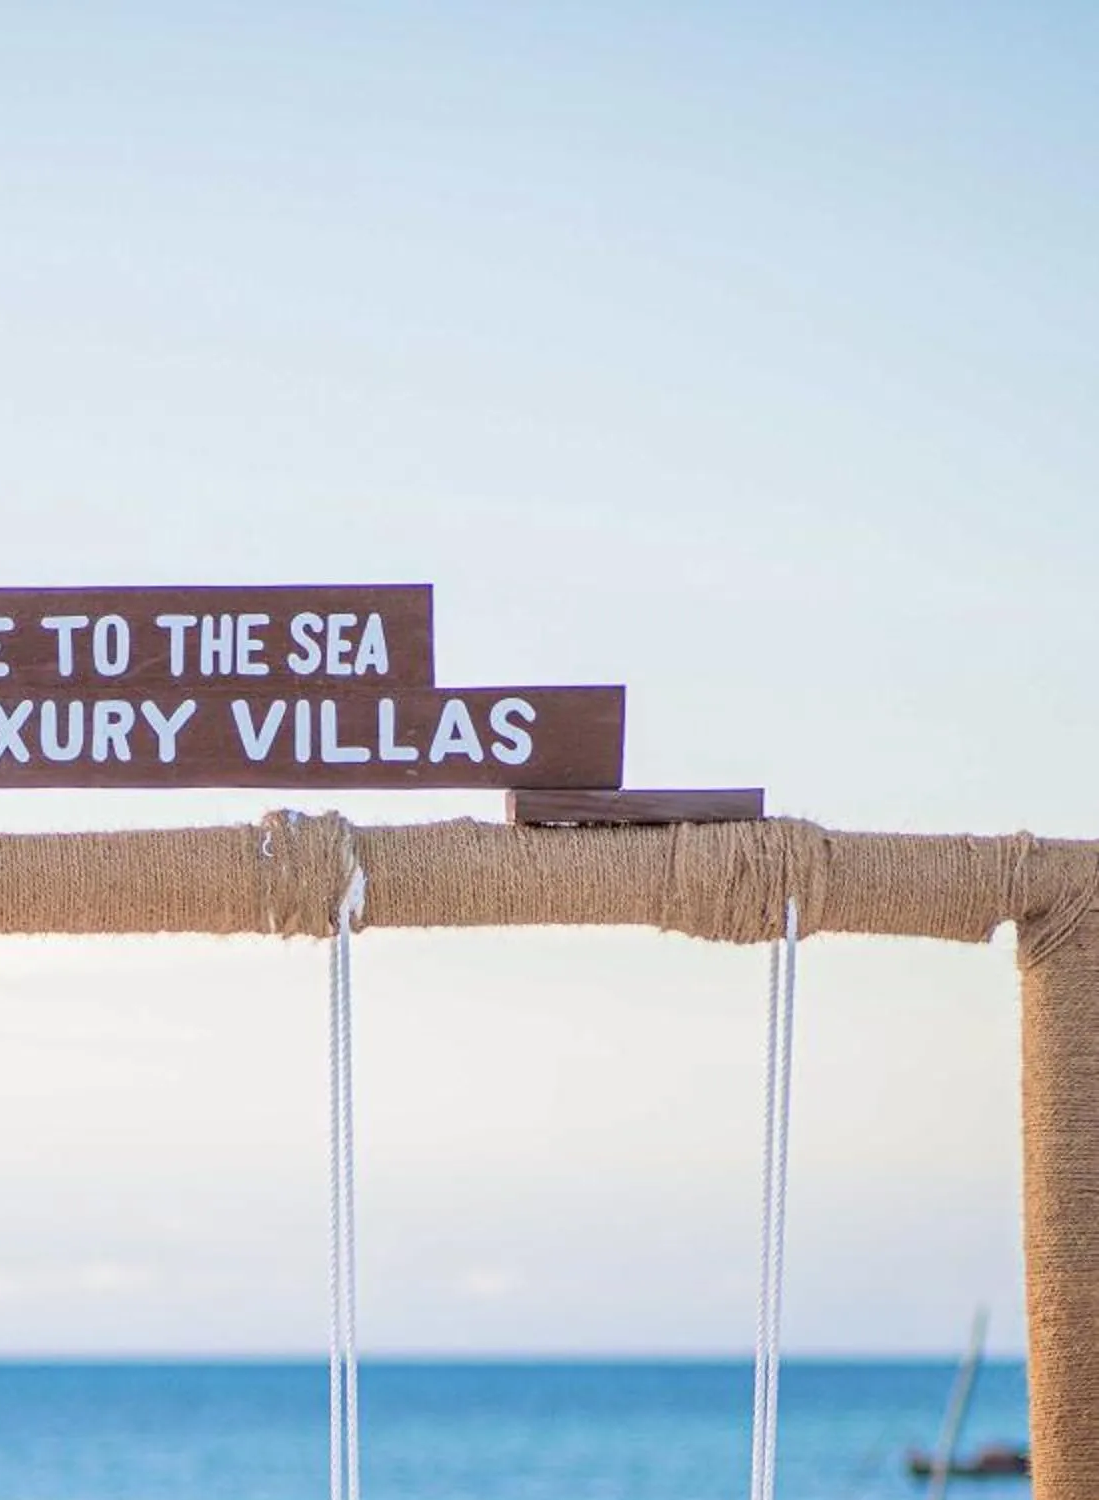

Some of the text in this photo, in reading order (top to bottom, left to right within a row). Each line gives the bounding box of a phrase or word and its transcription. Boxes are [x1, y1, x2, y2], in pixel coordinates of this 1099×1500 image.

[39, 613, 131, 678] TO
[154, 612, 271, 678] THE
[286, 611, 391, 677] SEA
[230, 696, 538, 766] VILLAS
